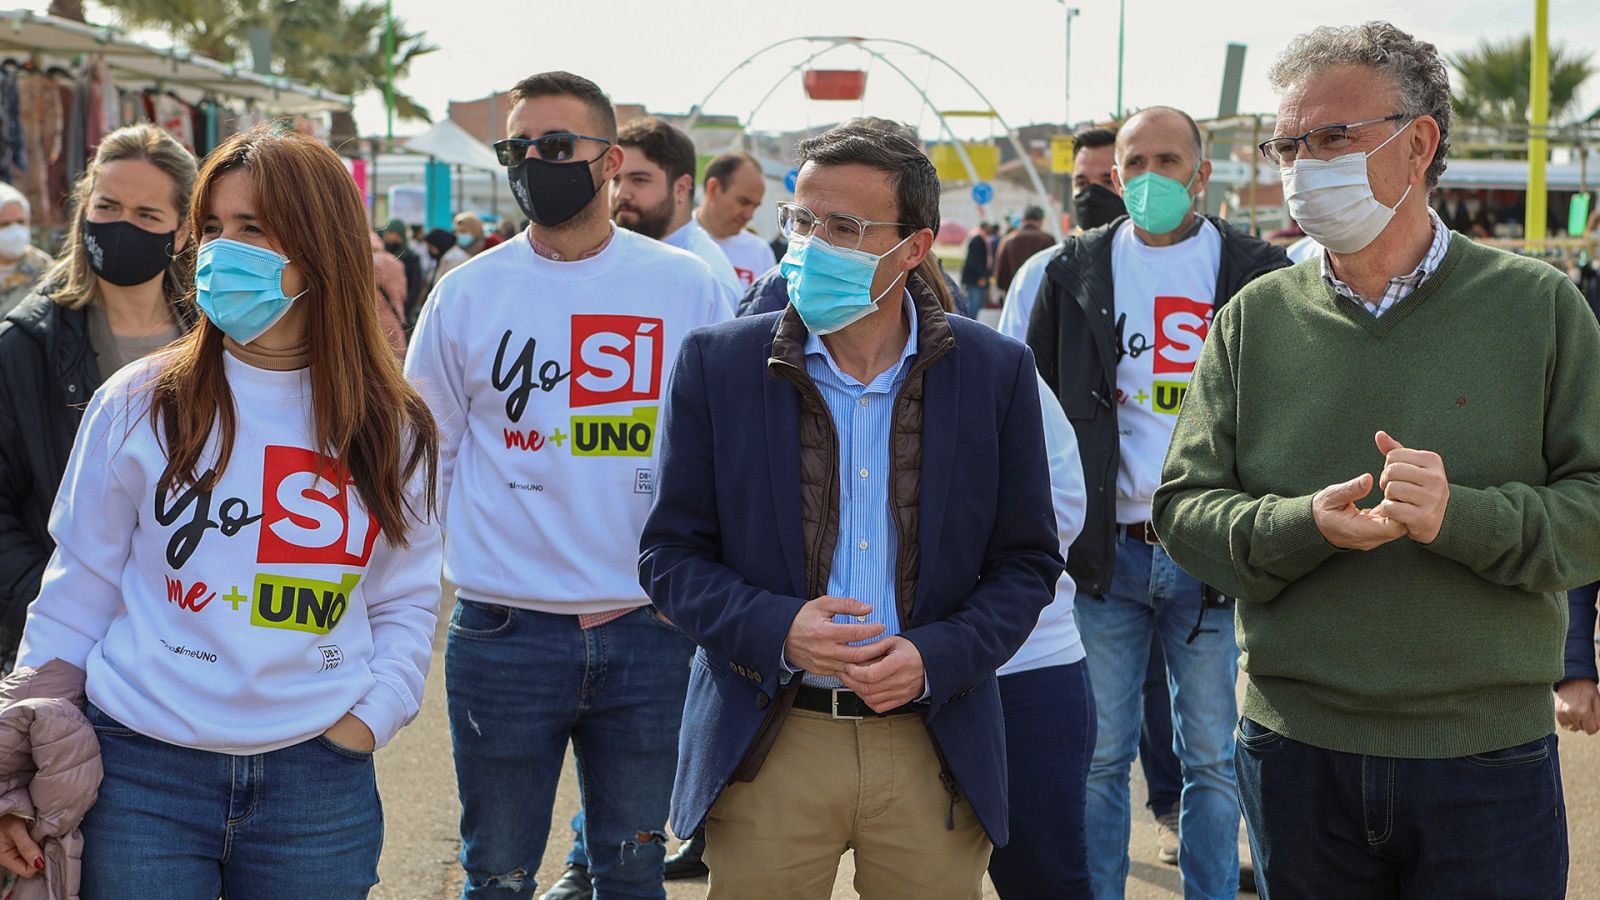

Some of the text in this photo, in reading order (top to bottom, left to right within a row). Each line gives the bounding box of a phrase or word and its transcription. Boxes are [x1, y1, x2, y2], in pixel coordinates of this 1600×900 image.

[491, 323, 658, 423] Yo SÍ
[503, 427, 545, 452] me
[575, 422, 652, 453] UNO
[155, 463, 265, 570] Yo
[165, 574, 216, 612] me
[258, 583, 346, 631] UNO
